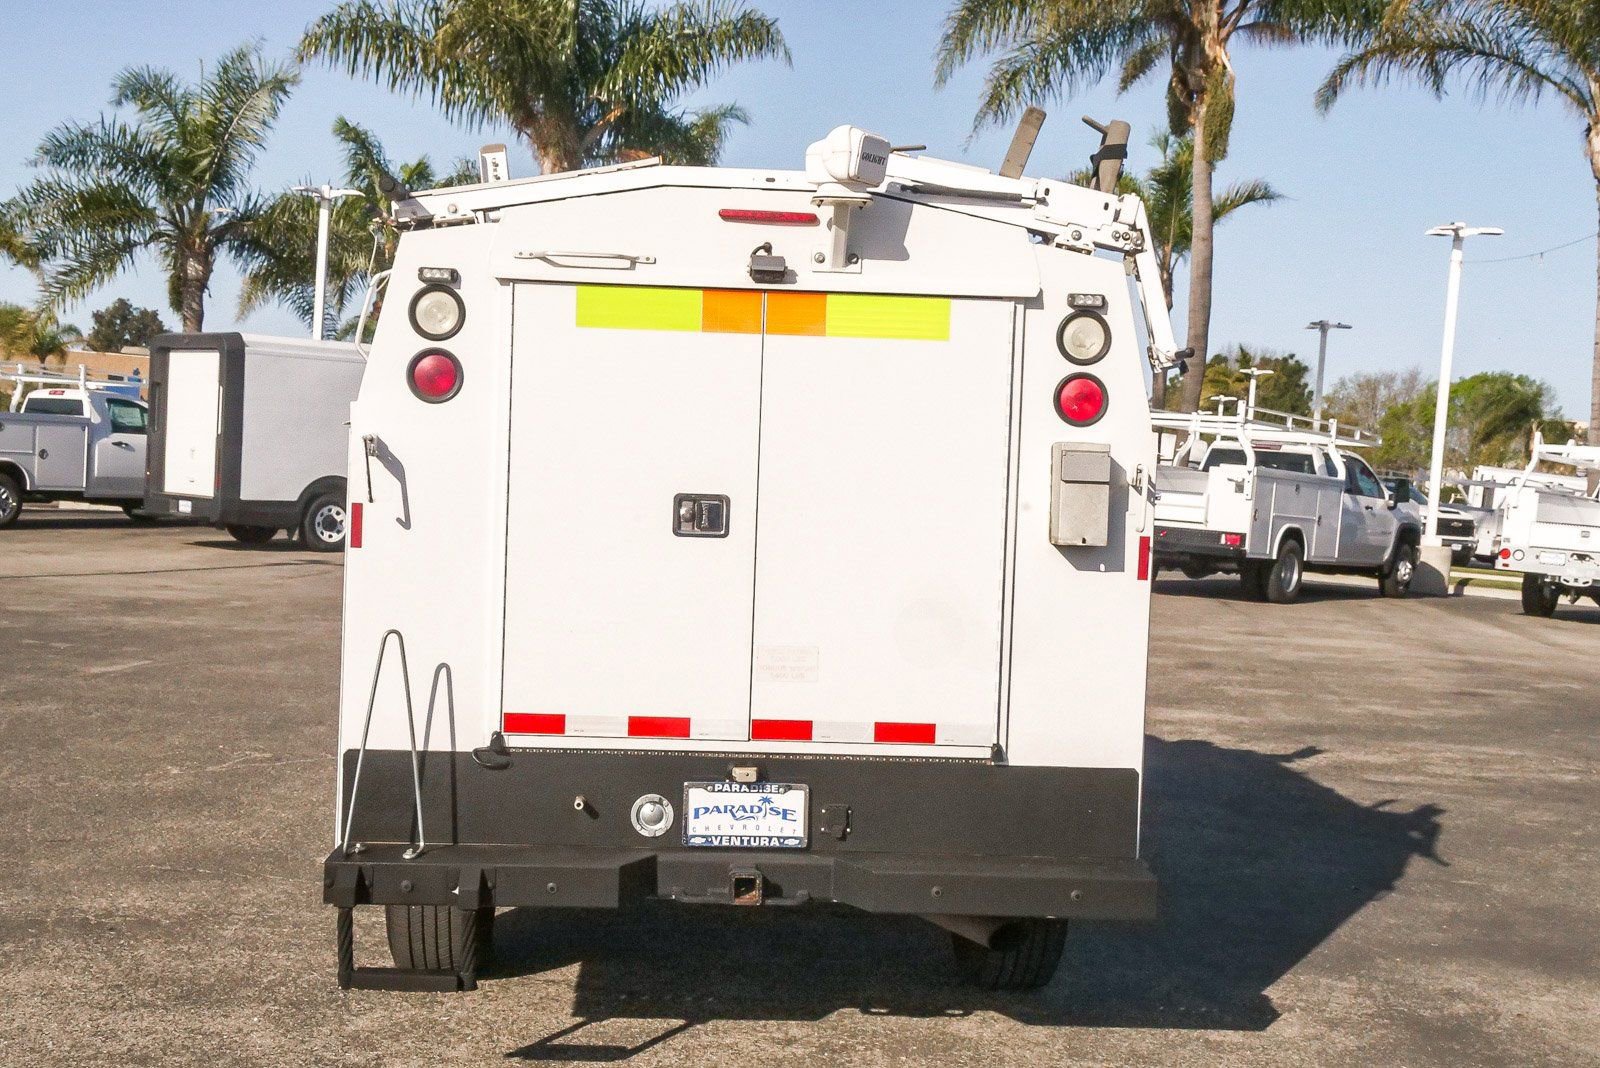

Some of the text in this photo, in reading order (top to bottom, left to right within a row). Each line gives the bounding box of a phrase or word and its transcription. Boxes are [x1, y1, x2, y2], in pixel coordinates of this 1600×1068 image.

[714, 783, 779, 793] PARADISE
[693, 797, 797, 822] PARADISE
[692, 824, 797, 835] CHEVROLET
[711, 836, 780, 847] VENTURA
